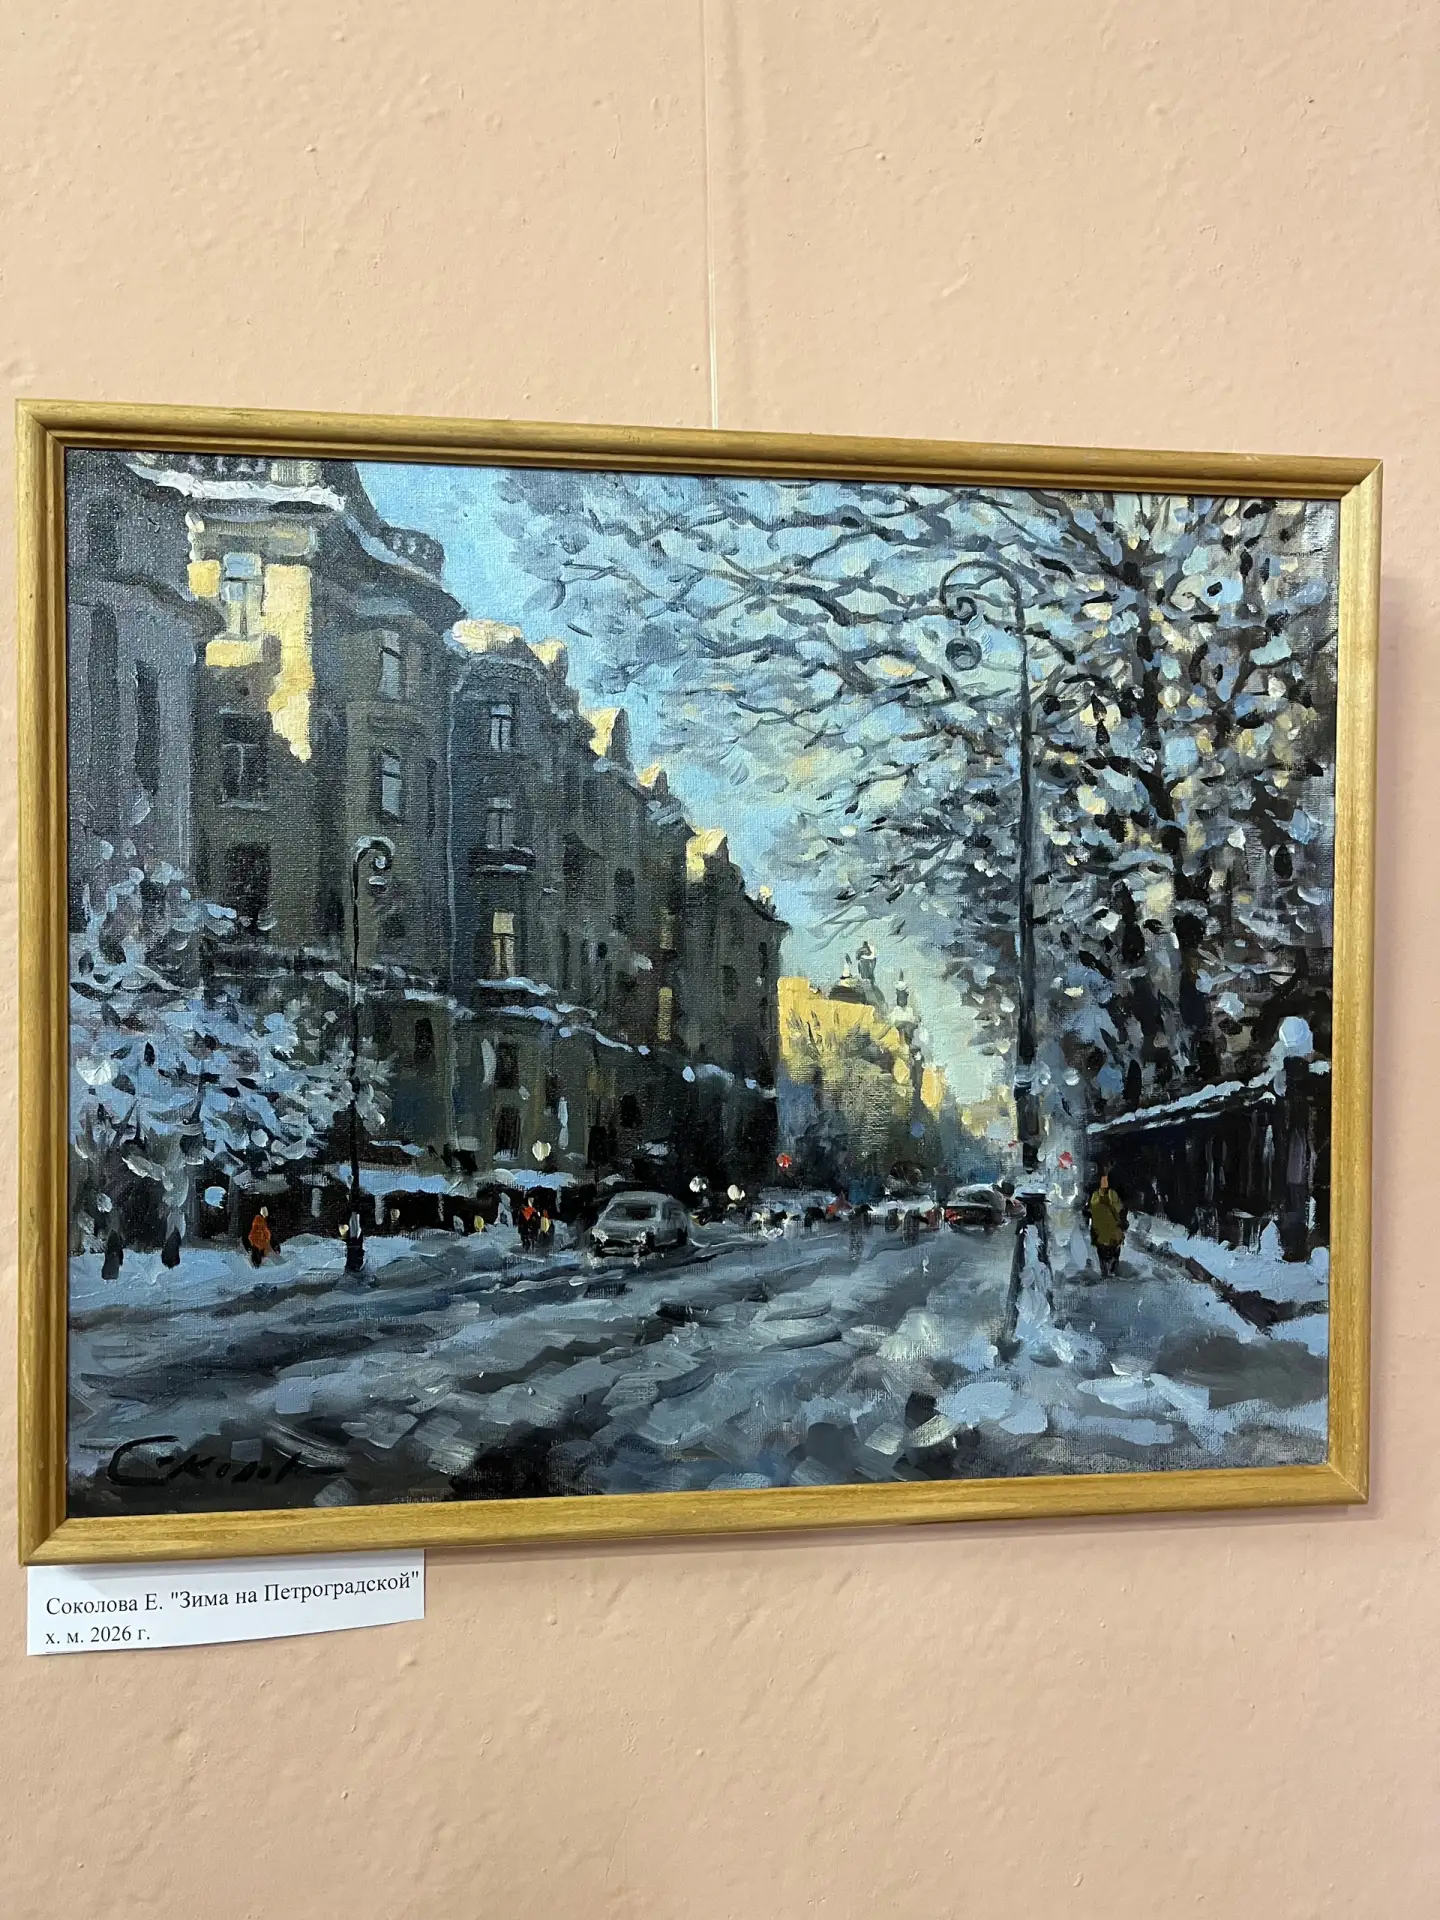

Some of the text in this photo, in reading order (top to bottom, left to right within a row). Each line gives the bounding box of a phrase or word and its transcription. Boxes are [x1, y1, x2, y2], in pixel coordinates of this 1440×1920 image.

[46, 1570, 420, 1615] Соколова Е. "Зима на Петроградской"
[45, 1625, 151, 1645] х. м. 2026 г.
